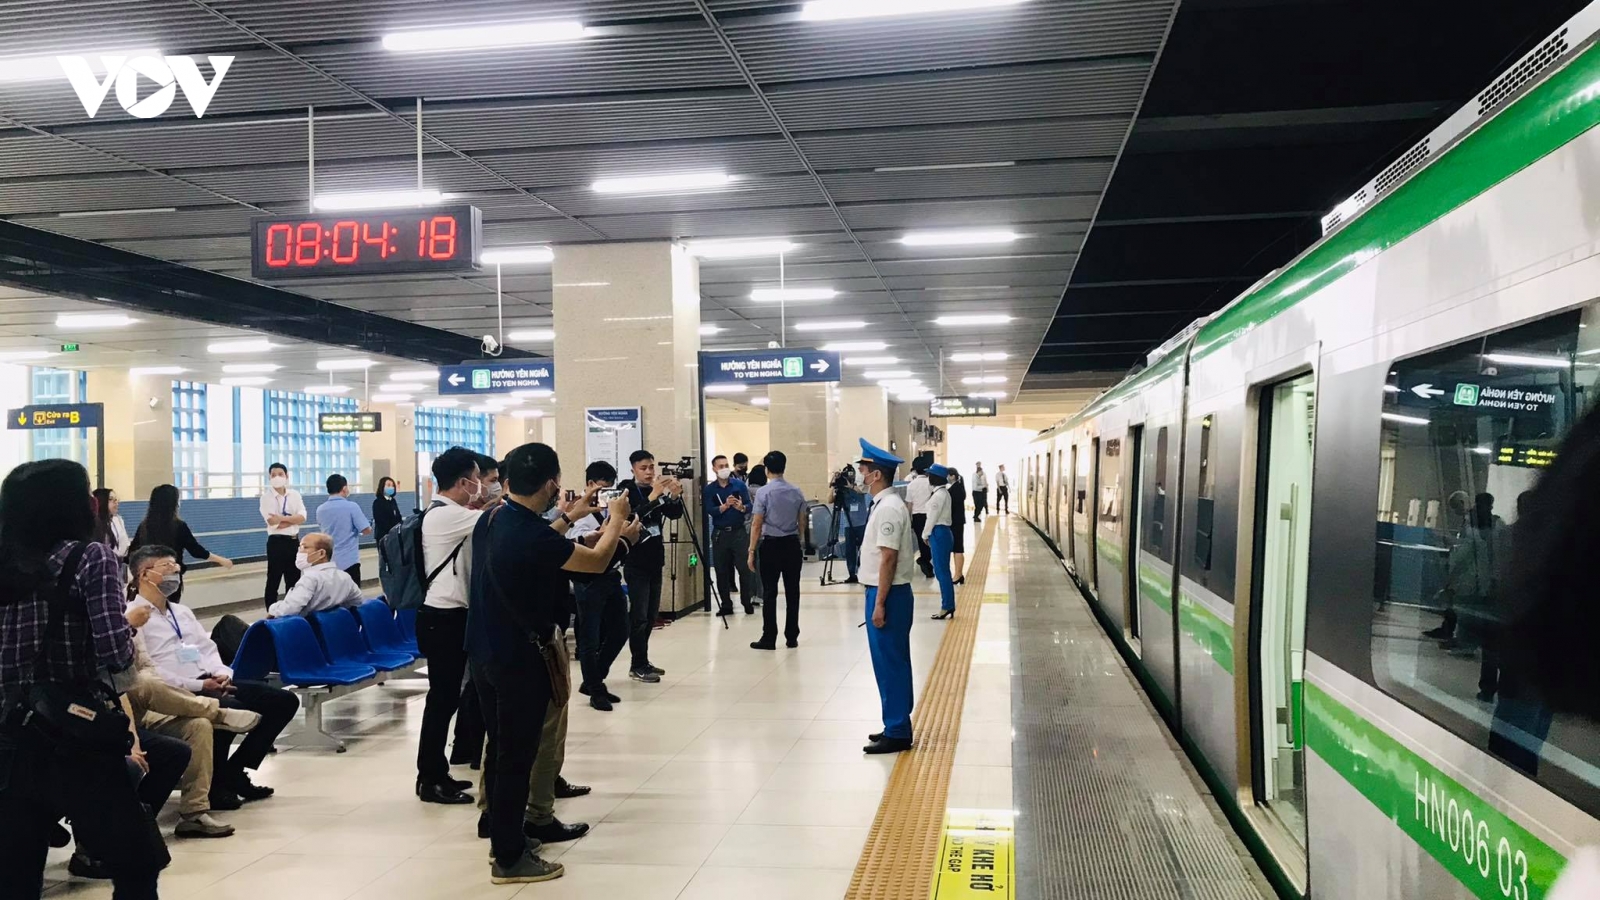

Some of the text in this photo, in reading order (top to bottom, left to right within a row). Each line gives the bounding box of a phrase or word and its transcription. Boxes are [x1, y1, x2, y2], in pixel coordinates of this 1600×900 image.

[721, 360, 745, 371] HƯỚNG
[747, 359, 760, 370] YÊN
[492, 369, 514, 379] HƯỚNG
[516, 368, 528, 378] YÊN
[70, 411, 80, 424] B
[1415, 771, 1528, 900] HN006 03
[950, 846, 964, 858] THE
[948, 858, 962, 872] GAP
[972, 849, 994, 870] KHE
[970, 874, 1004, 892] HỞ
